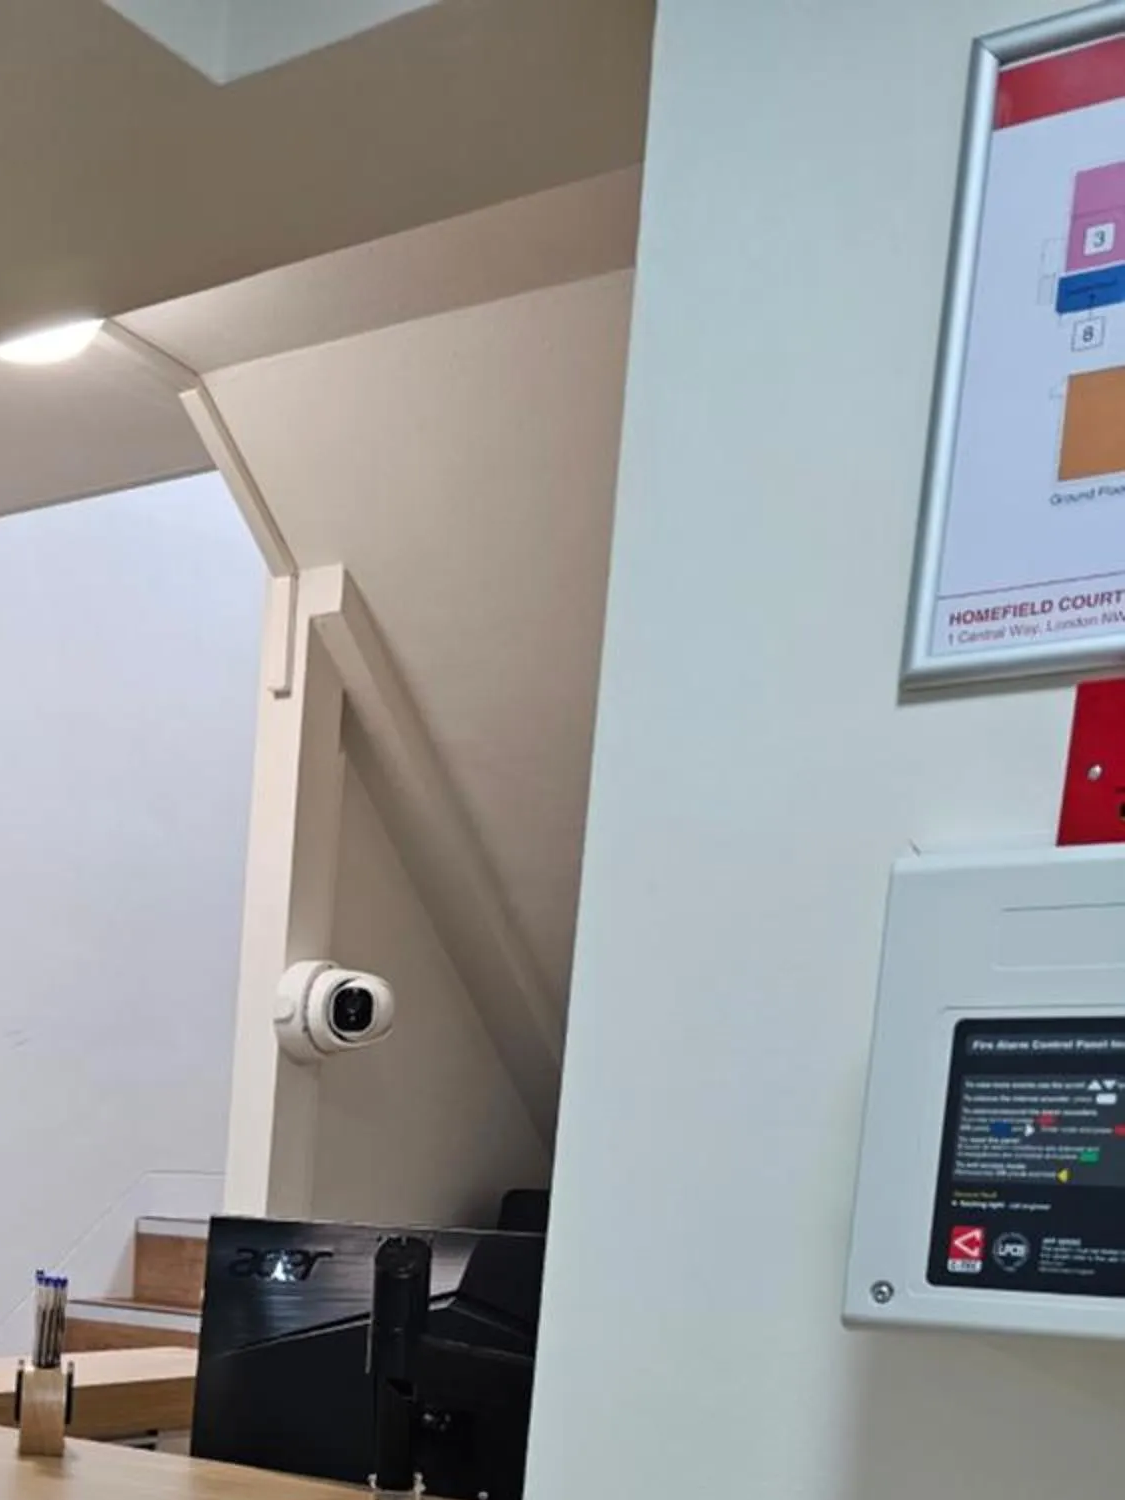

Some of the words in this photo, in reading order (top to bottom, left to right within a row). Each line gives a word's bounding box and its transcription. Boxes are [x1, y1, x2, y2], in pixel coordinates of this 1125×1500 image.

[1094, 230, 1105, 247] 3
[1082, 325, 1094, 342] 8
[1049, 487, 1095, 506] Ground
[949, 599, 1054, 626] HOMEFIELD
[1058, 590, 1125, 612] COURT
[948, 632, 954, 646] 1
[958, 624, 1006, 644] Central
[1046, 611, 1098, 633] London
[972, 1039, 993, 1050] Fire
[996, 1040, 1029, 1050] Alarm
[1032, 1039, 1074, 1050] Control
[1076, 1039, 1108, 1049] Panel
[230, 1248, 334, 1281] acer
